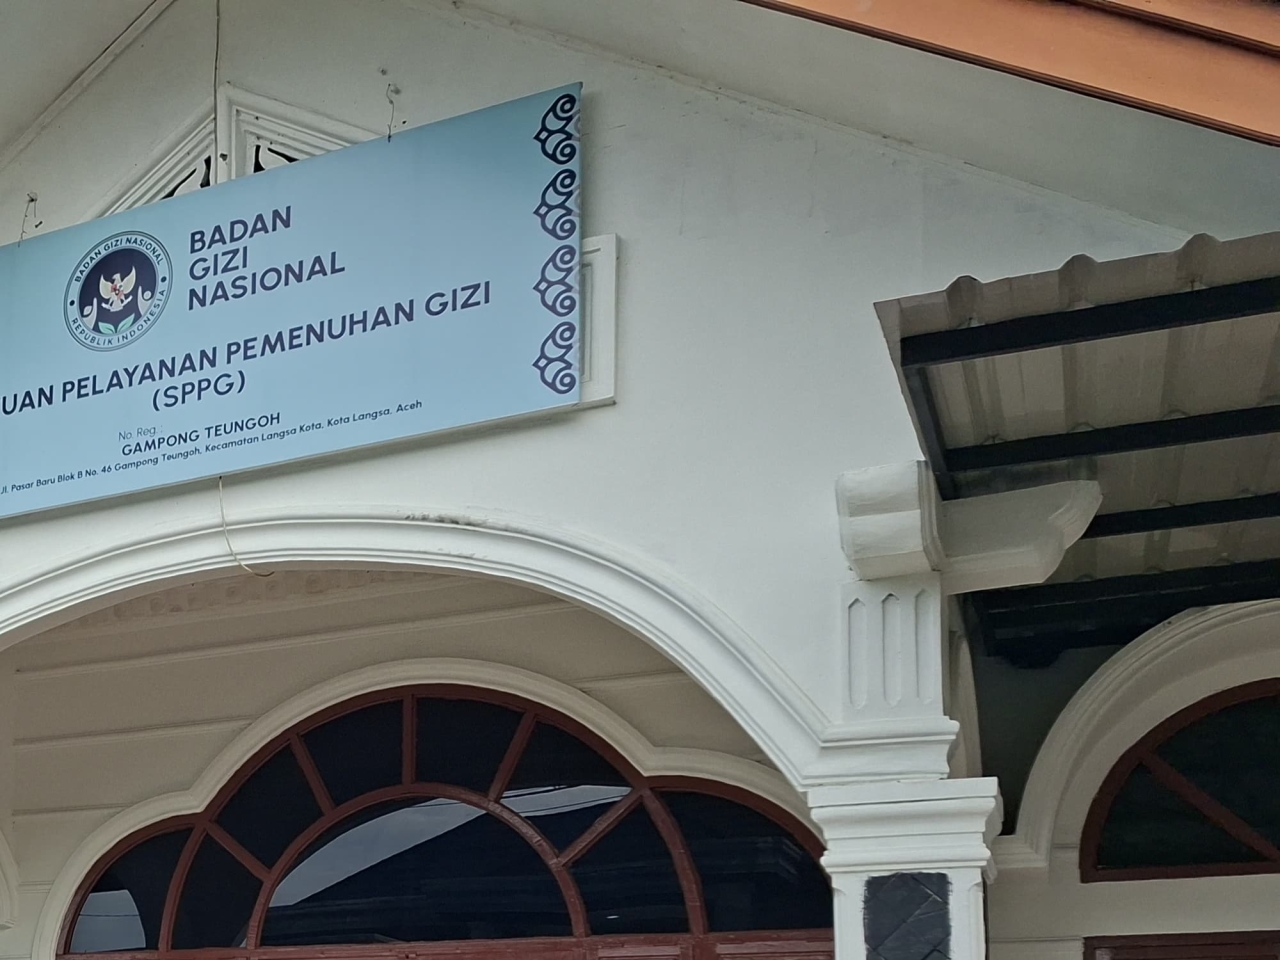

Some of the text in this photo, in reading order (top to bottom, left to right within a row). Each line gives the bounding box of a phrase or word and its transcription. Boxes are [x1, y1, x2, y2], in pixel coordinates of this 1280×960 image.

[190, 205, 292, 254] BADAN
[74, 236, 164, 283] BADAN GIZI NASIONAL
[188, 251, 346, 311] NASIONAL
[189, 246, 248, 281] GIZI
[62, 346, 218, 402] PELAYANAN
[226, 299, 414, 365] PEMENUHAN
[424, 280, 491, 317] GIZI
[71, 289, 166, 346] REPUBLIK INDONESIA
[152, 369, 246, 411] (SPPG)
[11, 481, 34, 493] Pasar
[36, 477, 56, 488] Baru
[57, 472, 75, 483] Blok
[77, 471, 83, 479] B
[85, 469, 99, 478] No.
[101, 465, 112, 474] 46
[114, 456, 159, 472] Gampong
[205, 436, 259, 453] Kecamatan
[261, 427, 297, 442] Langsa
[327, 416, 350, 428] Kota
[396, 400, 423, 413] Aceh
[118, 431, 134, 441] No.
[121, 412, 281, 456] GAMPONG TEUNGOH
